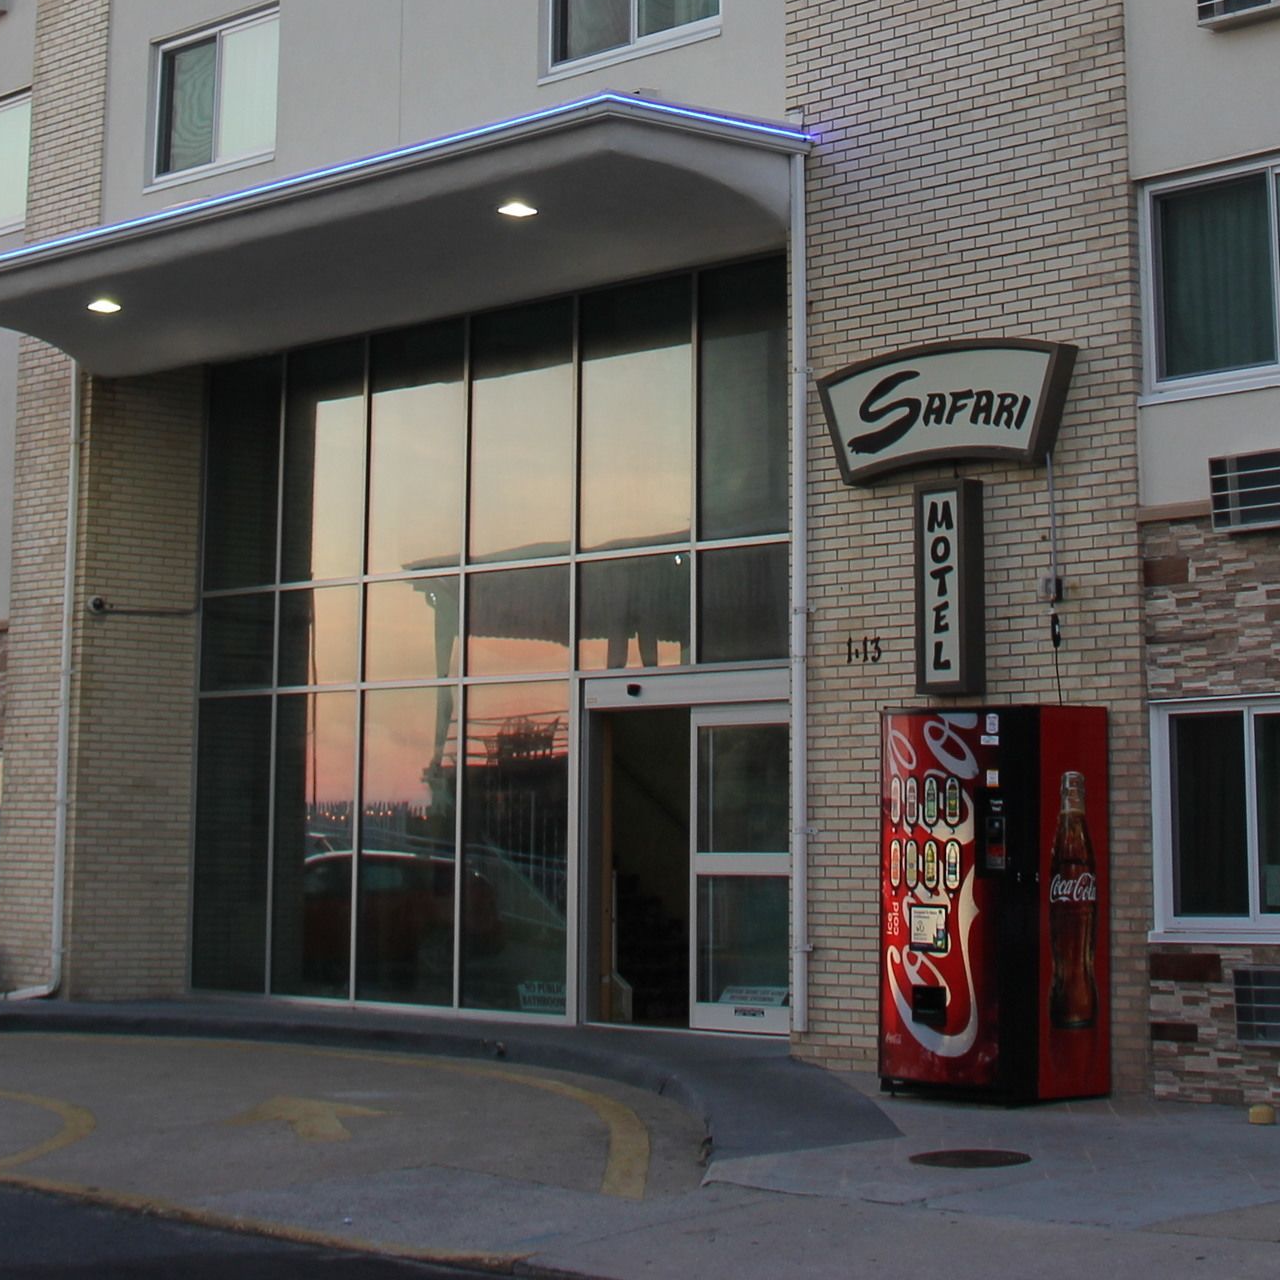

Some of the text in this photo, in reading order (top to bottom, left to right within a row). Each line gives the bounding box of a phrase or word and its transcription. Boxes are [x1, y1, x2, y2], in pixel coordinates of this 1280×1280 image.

[847, 369, 1032, 454] SAFARI
[927, 500, 954, 671] MOTEL
[892, 902, 900, 935] cold
